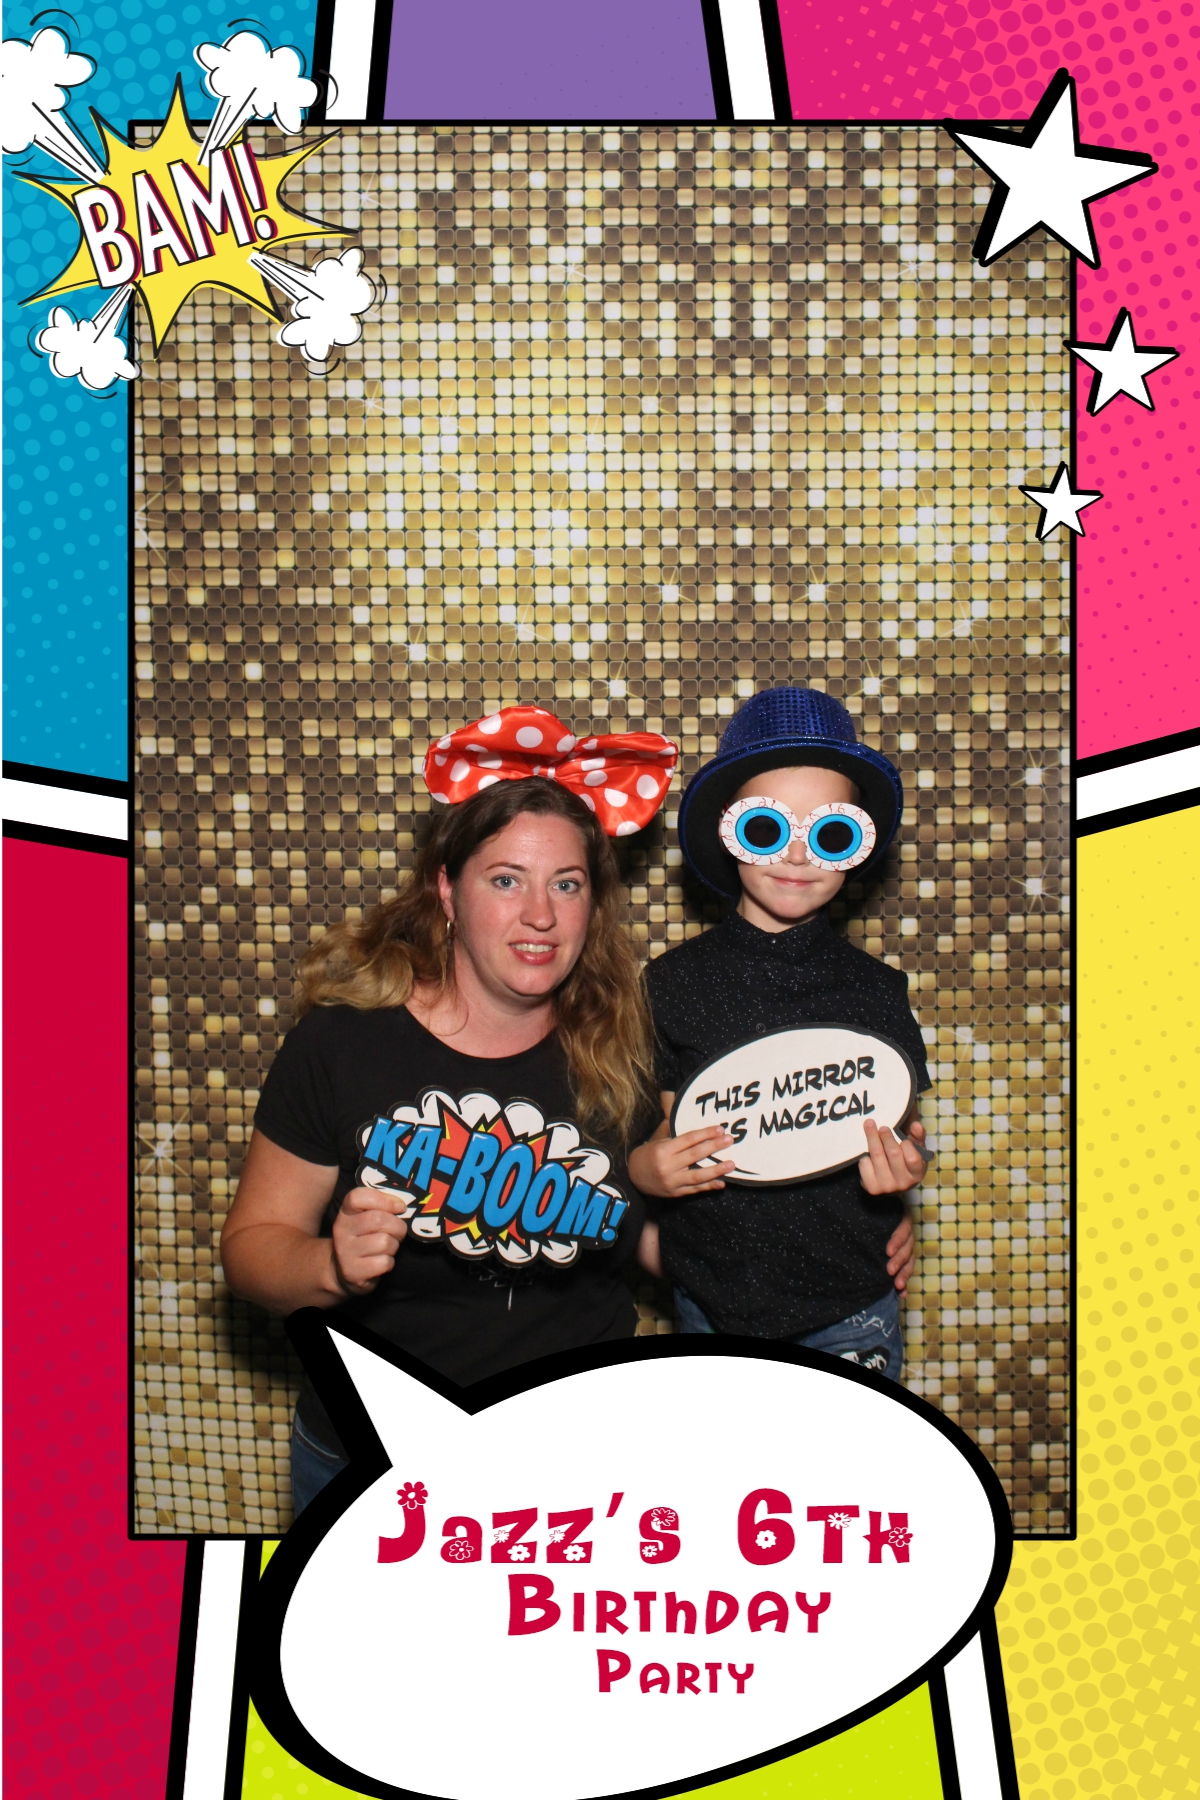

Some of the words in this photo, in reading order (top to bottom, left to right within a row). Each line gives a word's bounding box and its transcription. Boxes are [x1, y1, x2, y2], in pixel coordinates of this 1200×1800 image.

[695, 1081, 761, 1117] THIS
[772, 1056, 876, 1101] MIRROR
[759, 1090, 876, 1138] MAGICAL
[363, 1116, 629, 1242] KA-BOOM!
